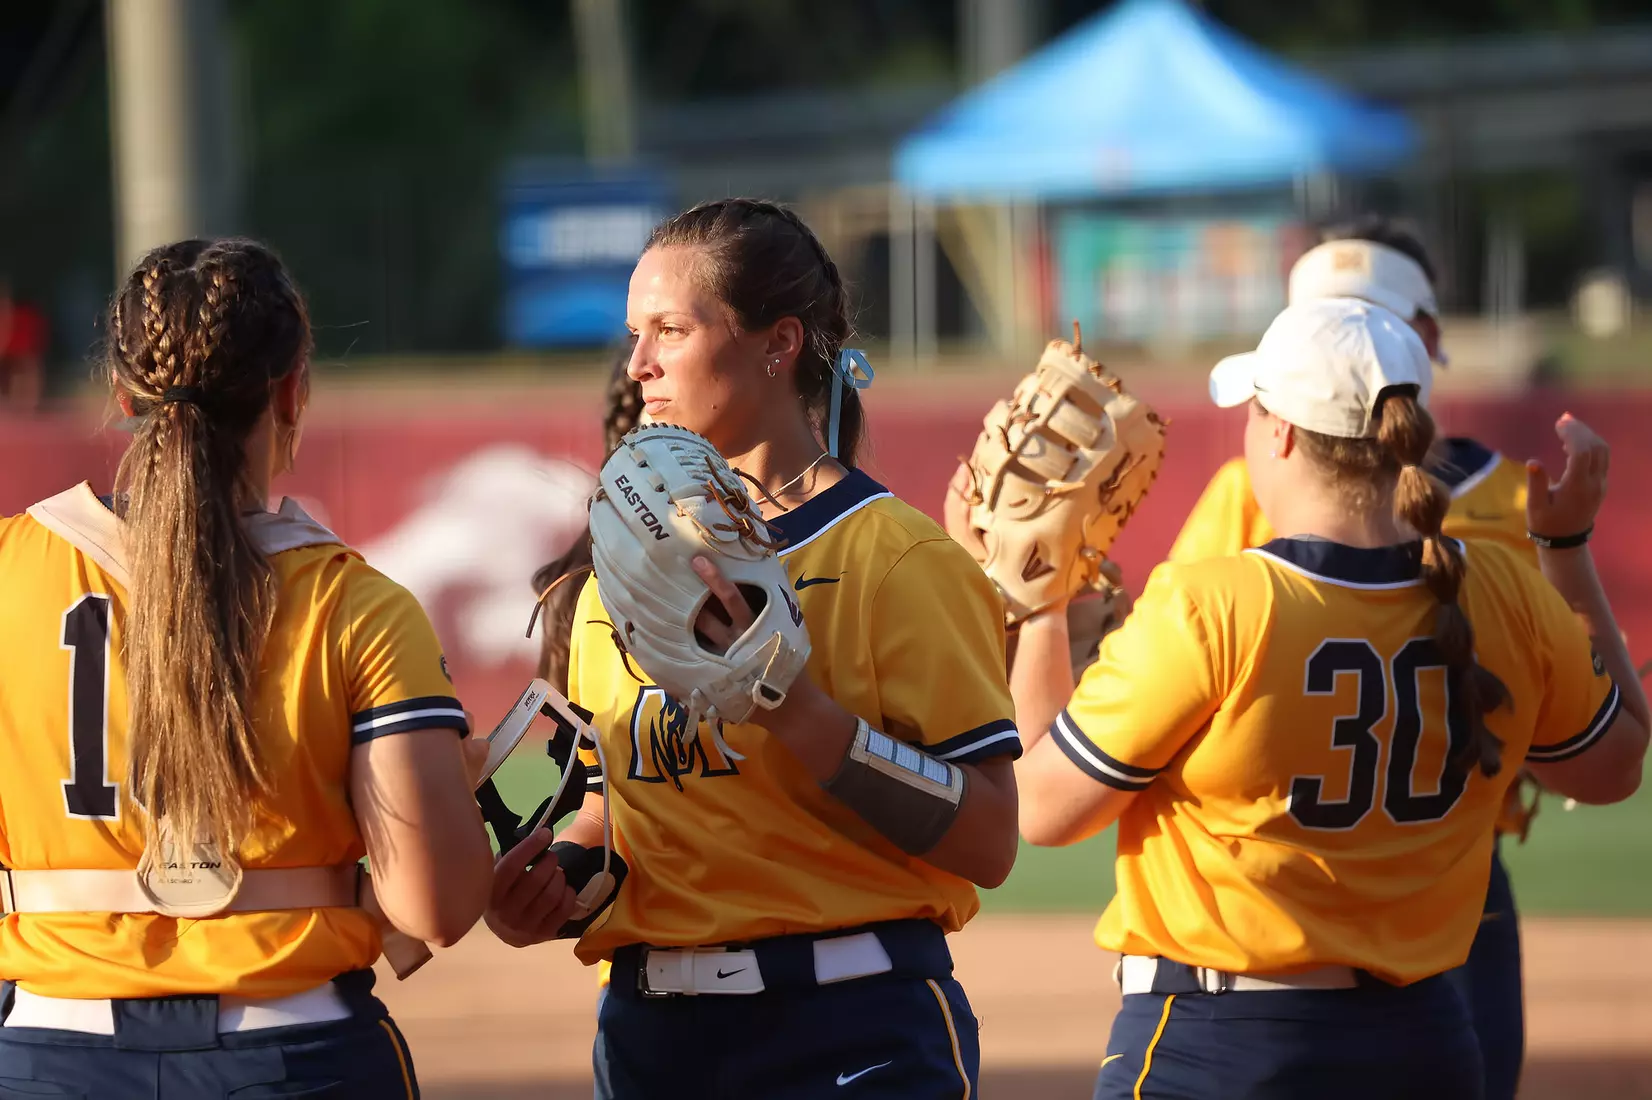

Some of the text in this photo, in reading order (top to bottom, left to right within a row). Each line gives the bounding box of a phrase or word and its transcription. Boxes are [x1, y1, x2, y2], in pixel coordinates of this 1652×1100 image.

[614, 474, 670, 541] EASTON
[59, 592, 166, 821] 1
[1285, 637, 1476, 832] 30
